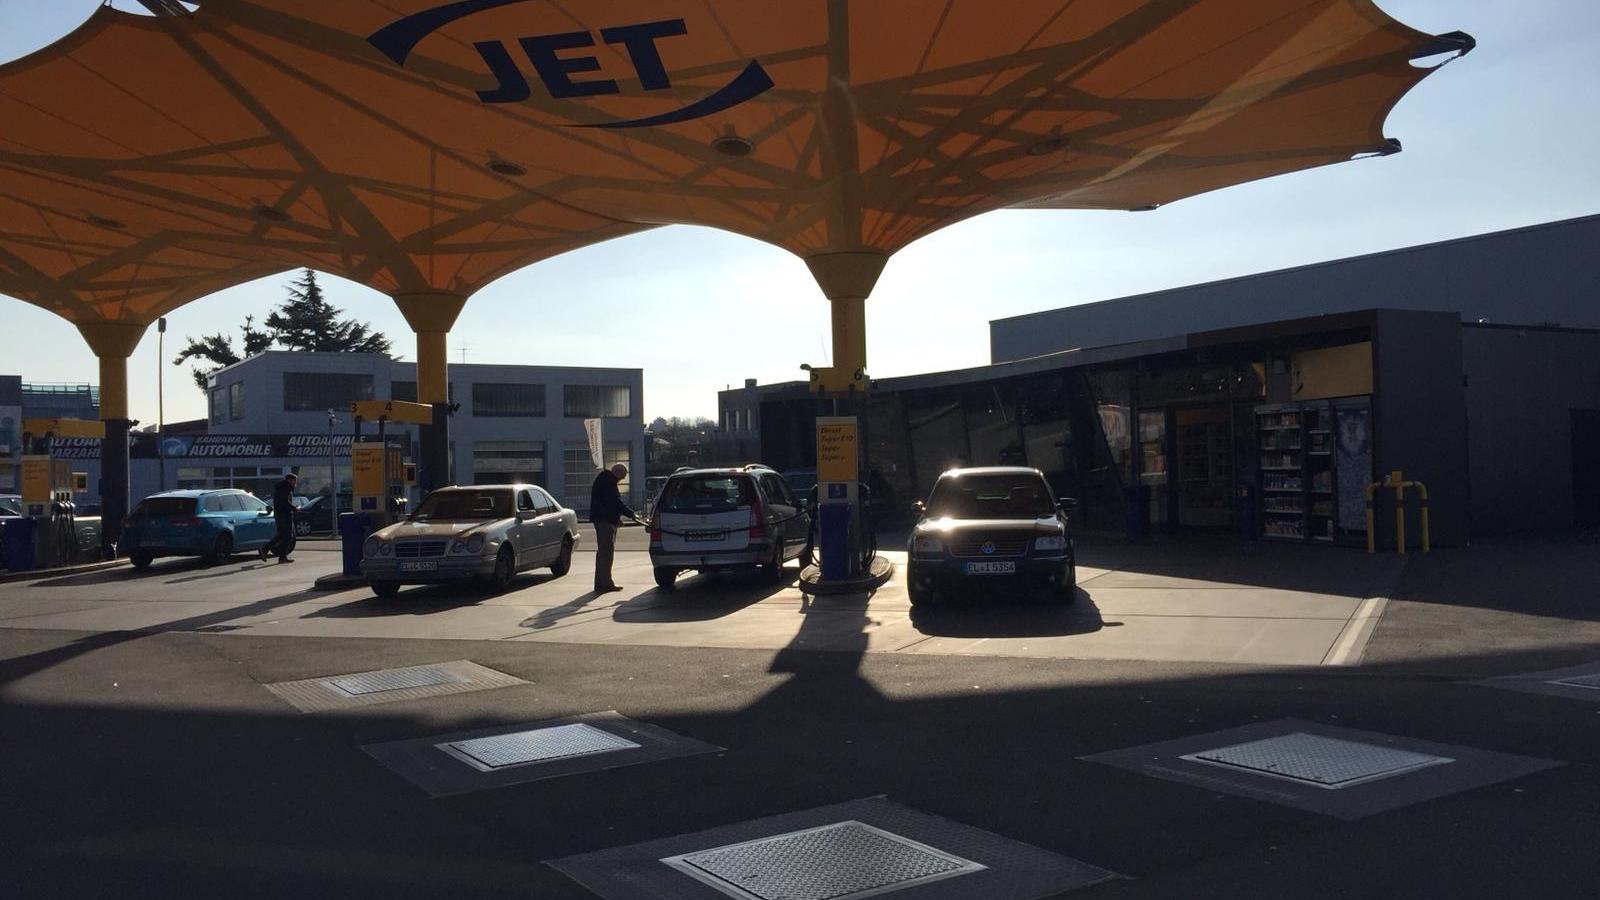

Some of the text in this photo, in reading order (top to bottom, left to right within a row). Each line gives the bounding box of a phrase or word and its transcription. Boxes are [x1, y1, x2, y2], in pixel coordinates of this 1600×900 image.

[473, 18, 688, 103] JET
[854, 368, 862, 381] 6
[351, 402, 358, 413] 3
[385, 401, 392, 412] 4
[189, 444, 272, 456] AUTOMOBILE
